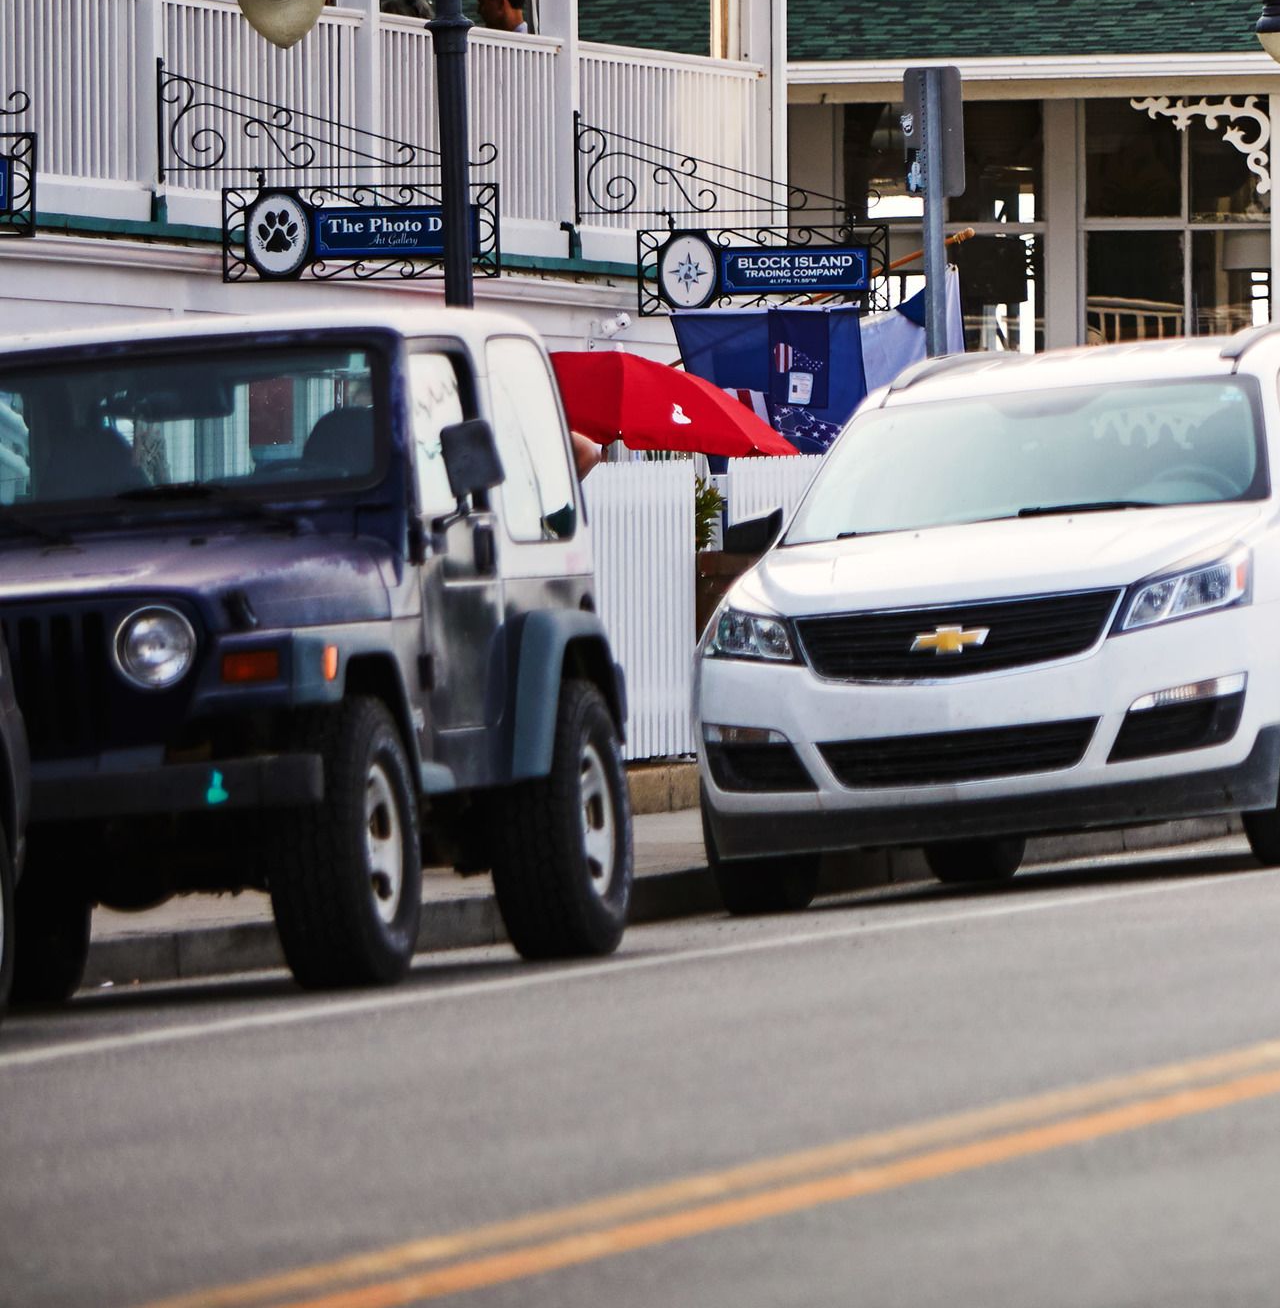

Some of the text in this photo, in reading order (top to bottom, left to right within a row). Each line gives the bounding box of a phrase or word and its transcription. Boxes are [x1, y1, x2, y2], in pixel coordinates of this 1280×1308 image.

[327, 218, 365, 234] The
[369, 217, 422, 233] Photo
[369, 232, 418, 247] Art Gallery
[737, 255, 853, 269] BLOCK ISLAND
[744, 267, 844, 278] TRADING COMPANY
